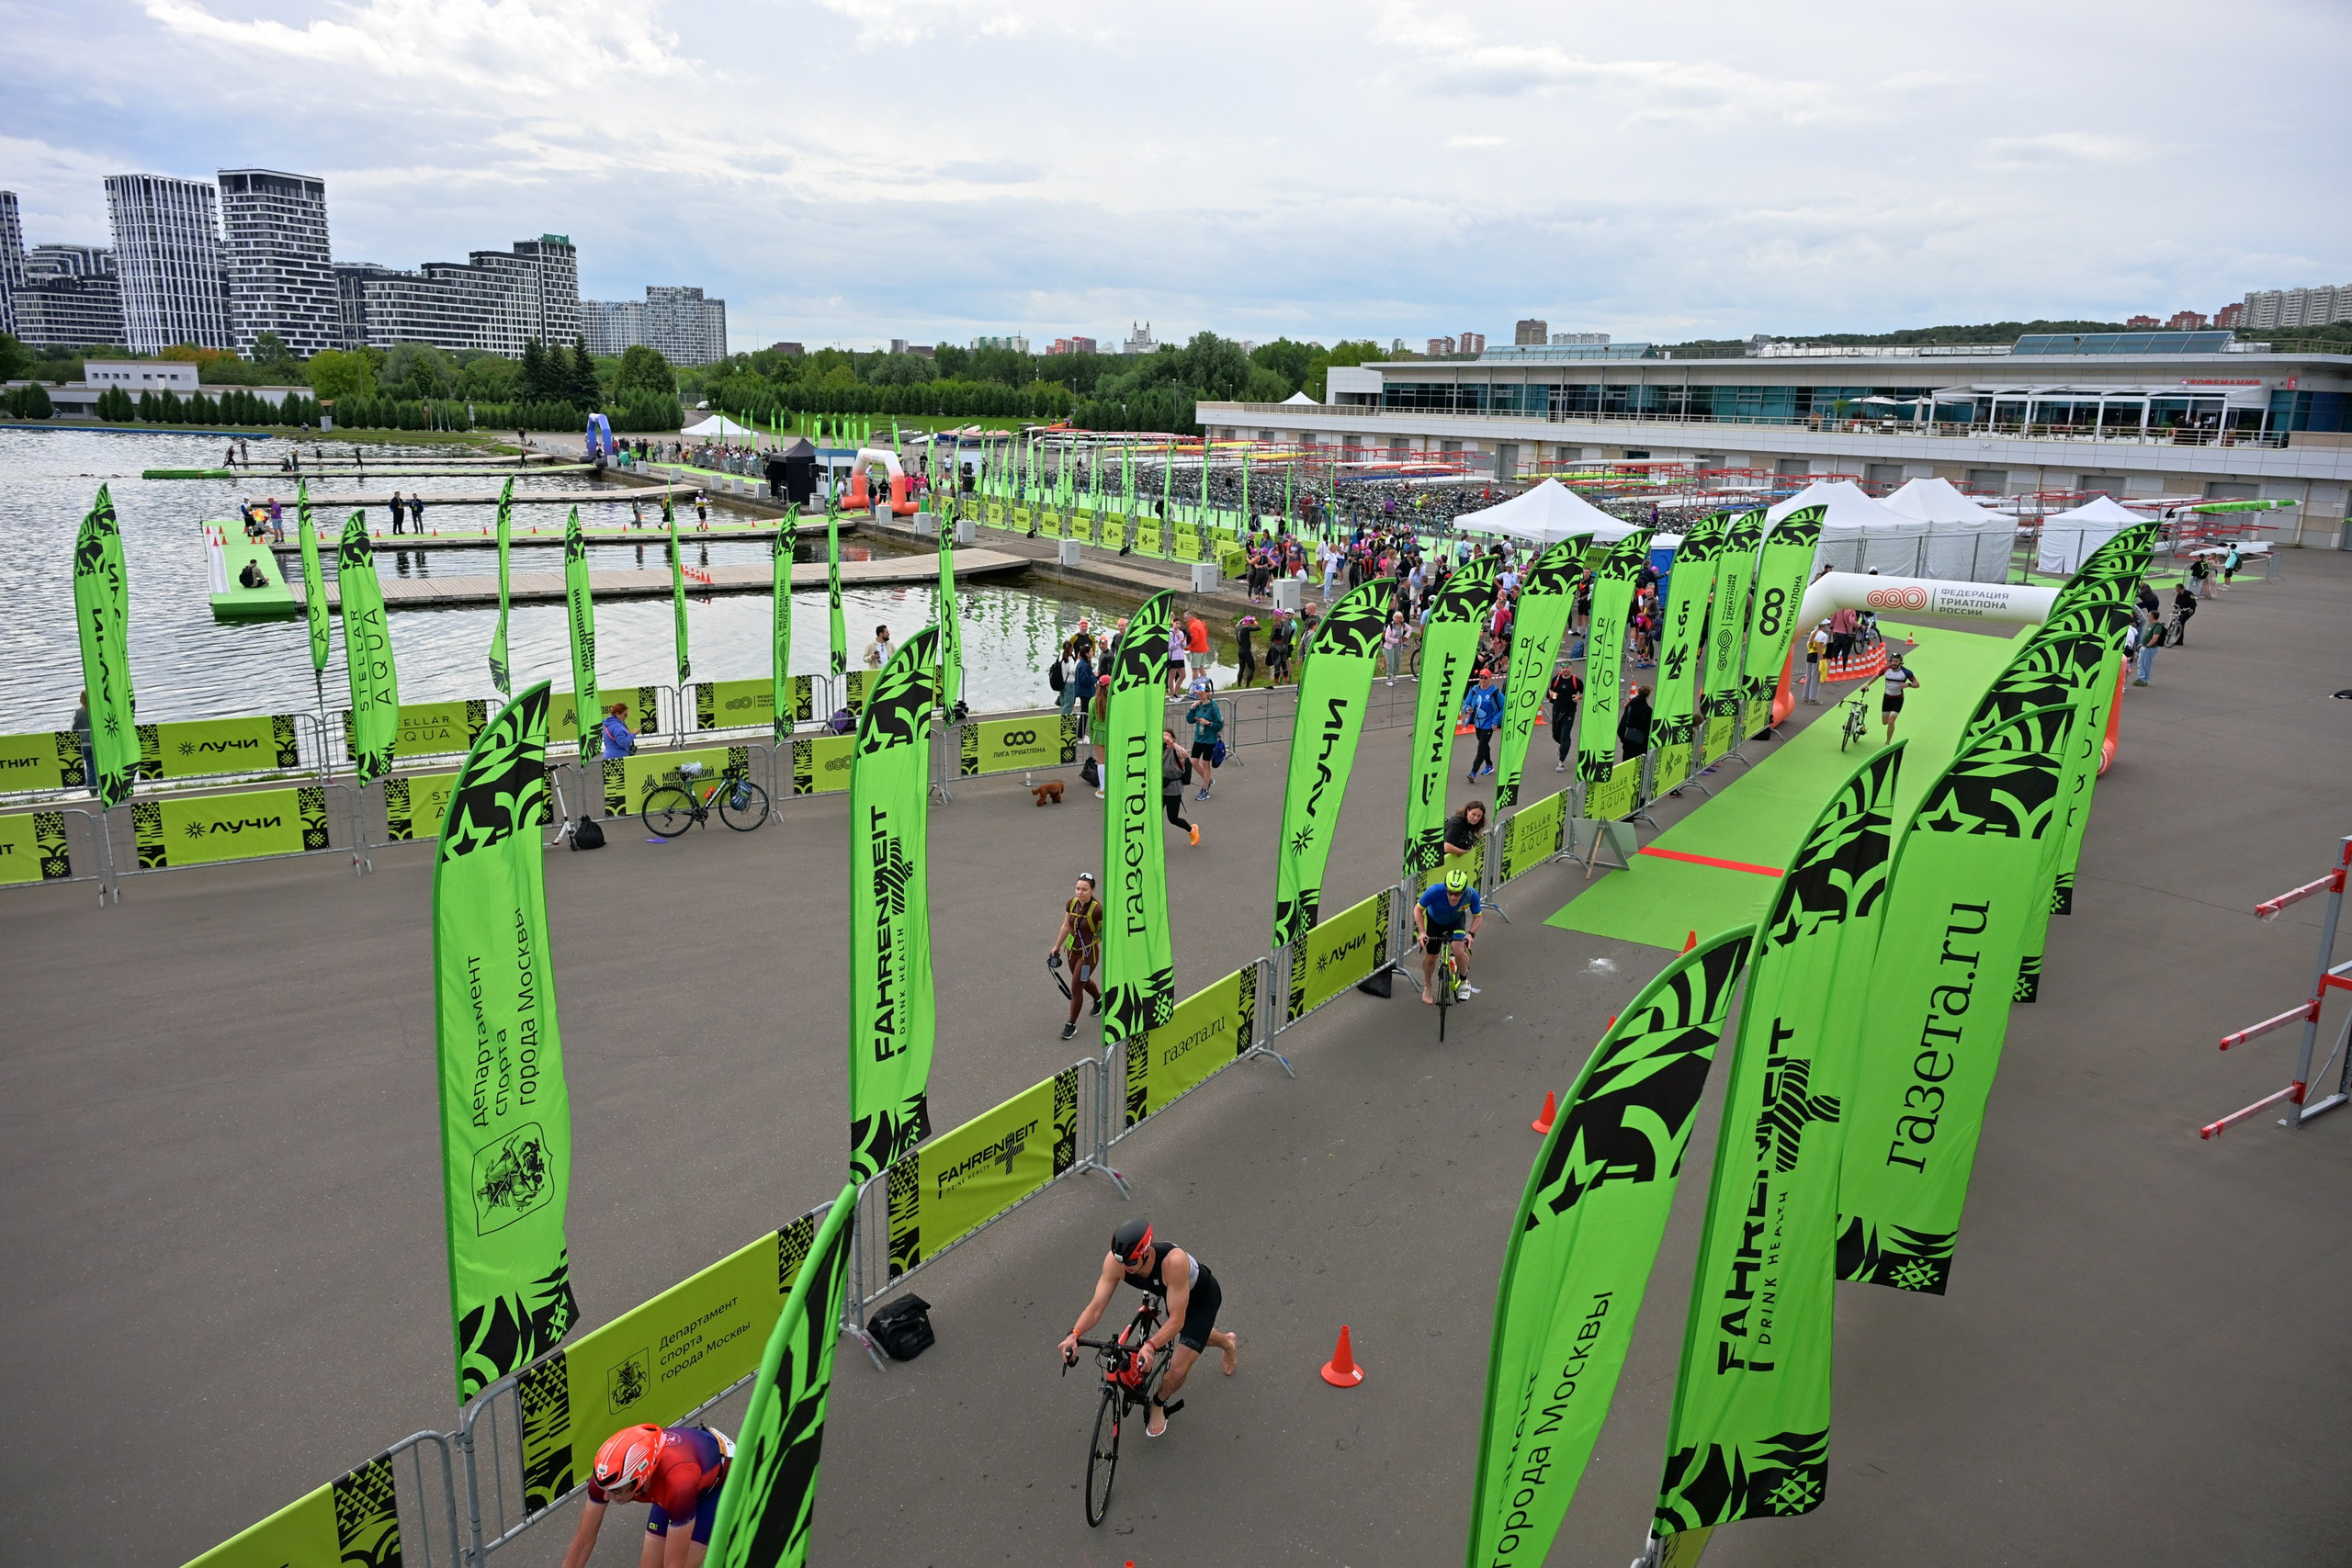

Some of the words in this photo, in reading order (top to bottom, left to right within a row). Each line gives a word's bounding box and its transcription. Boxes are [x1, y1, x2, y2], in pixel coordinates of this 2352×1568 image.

[1045, 519, 1056, 527] Haier
[1075, 525, 1087, 533] Haier
[1678, 600, 1690, 637] сбп
[1726, 574, 1737, 620] ТРИАТЛОНА
[1785, 575, 1804, 626] ТРИАТЛОНА
[1939, 606, 1983, 616] РОССИИ
[1940, 597, 2007, 609] ТРИАТЛОНА
[1941, 588, 2009, 599] ФЕДЕРАЦИЯ
[364, 608, 392, 705] AQUA
[572, 588, 591, 672] МОСКОВСКИЙ
[350, 609, 369, 712] STELLAR
[1517, 636, 1550, 736] AQUA
[1592, 616, 1605, 714] STELLAR
[1598, 619, 1616, 713] AQUA
[1430, 651, 1457, 762] МАГНИТ
[1505, 637, 1532, 741] STELLAR
[199, 738, 258, 757] ЛУЧИ
[398, 716, 450, 726] ELLAR
[993, 749, 1009, 759] ЛИГА
[1011, 746, 1046, 757] ТРИАТЛОНА
[1306, 698, 1348, 818] ЛУЧИ
[1600, 791, 1625, 812] AQUA
[1601, 775, 1628, 795] STELLAR
[209, 816, 281, 835] ЛУЧИ
[1125, 731, 1148, 938] газета.ru
[1520, 829, 1549, 855] AQUA
[1521, 813, 1551, 837] STELLAR
[514, 908, 534, 1013] Москвы
[897, 928, 905, 983] HEALTH
[1329, 931, 1366, 965] ЛУЧИ
[468, 955, 489, 1129] Департамент
[518, 1018, 538, 1106] города
[1162, 1016, 1226, 1066] газета.ru
[1885, 900, 1990, 1174] газета.ru
[495, 1028, 511, 1117] спорта
[937, 1119, 1039, 1189] FAHRENHEIT
[946, 1179, 966, 1194] DRINK
[967, 1163, 991, 1180] HEALTH
[659, 1296, 739, 1352] Департамент
[1758, 1277, 1778, 1345] DRINK
[660, 1334, 704, 1366] спорта
[661, 1350, 704, 1382] города
[706, 1321, 752, 1354] Москвы
[1532, 1291, 1613, 1437] Москвы
